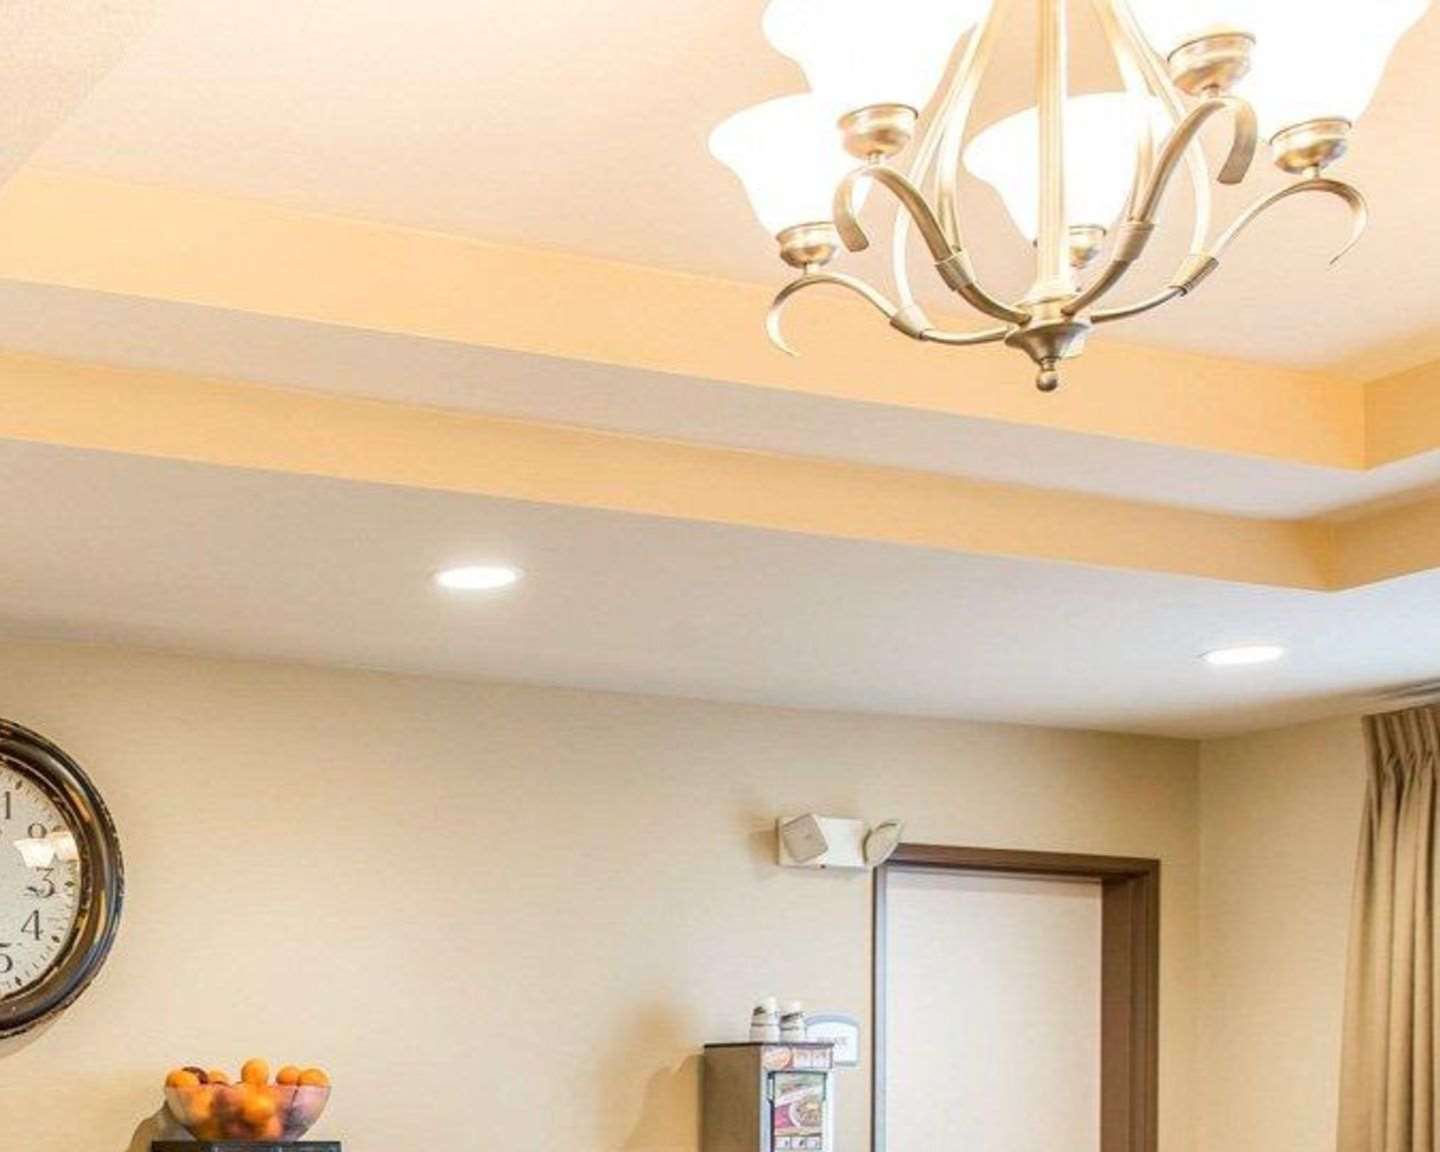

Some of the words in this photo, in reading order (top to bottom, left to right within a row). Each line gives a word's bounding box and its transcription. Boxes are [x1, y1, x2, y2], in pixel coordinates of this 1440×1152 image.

[4, 791, 11, 819] 1
[27, 866, 56, 898] 3
[20, 909, 44, 941] 4
